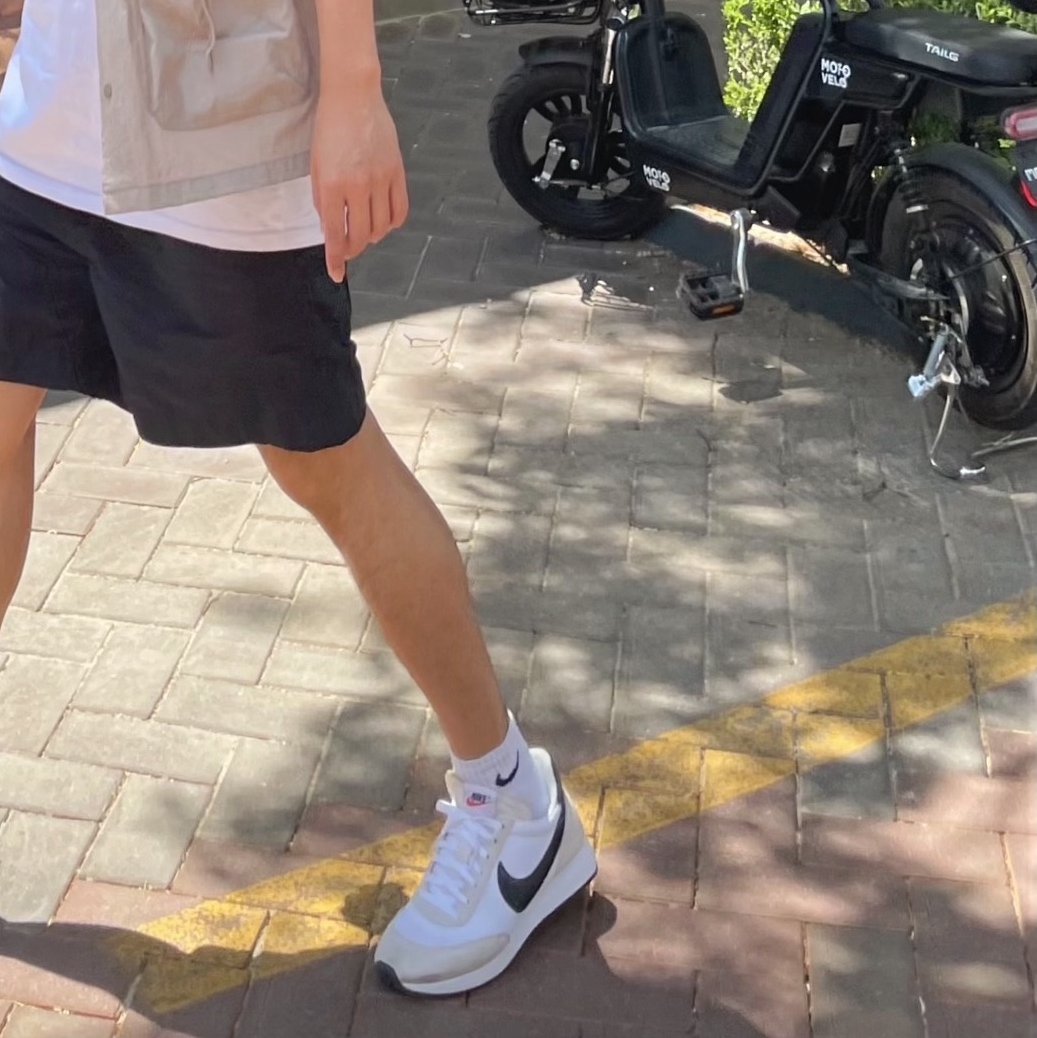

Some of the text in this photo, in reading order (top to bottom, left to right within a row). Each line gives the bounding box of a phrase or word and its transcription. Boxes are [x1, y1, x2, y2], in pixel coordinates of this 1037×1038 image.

[925, 42, 960, 62] TAILG
[821, 58, 851, 78] MOTO
[821, 72, 847, 89] VELO
